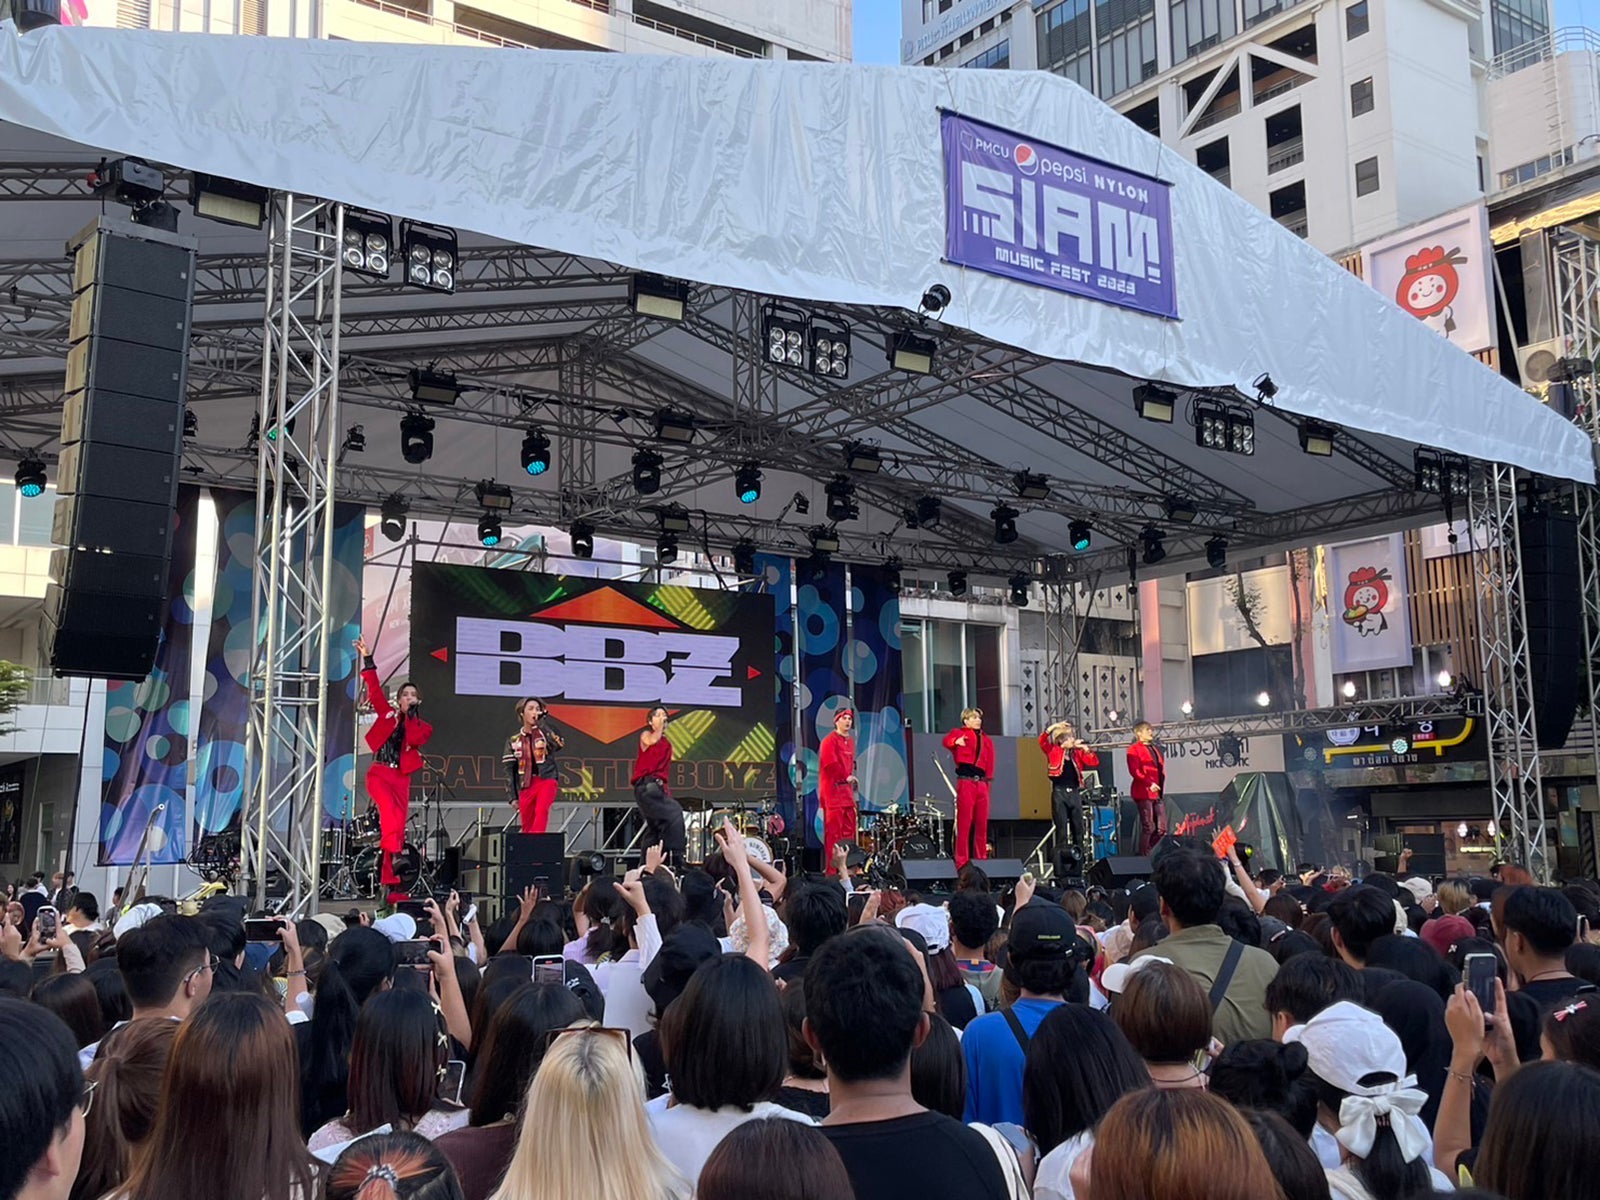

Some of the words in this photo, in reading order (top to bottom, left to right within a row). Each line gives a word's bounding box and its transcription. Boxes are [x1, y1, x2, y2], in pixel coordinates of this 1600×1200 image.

[975, 138, 1010, 158] PMCU
[1041, 158, 1088, 184] pepsi
[1094, 174, 1149, 204] NYLON
[995, 247, 1046, 273] MUSIC
[1050, 261, 1092, 284] FEST
[1097, 274, 1137, 295] 2023
[455, 616, 741, 707] BBZ
[668, 759, 777, 792] BOYZ
